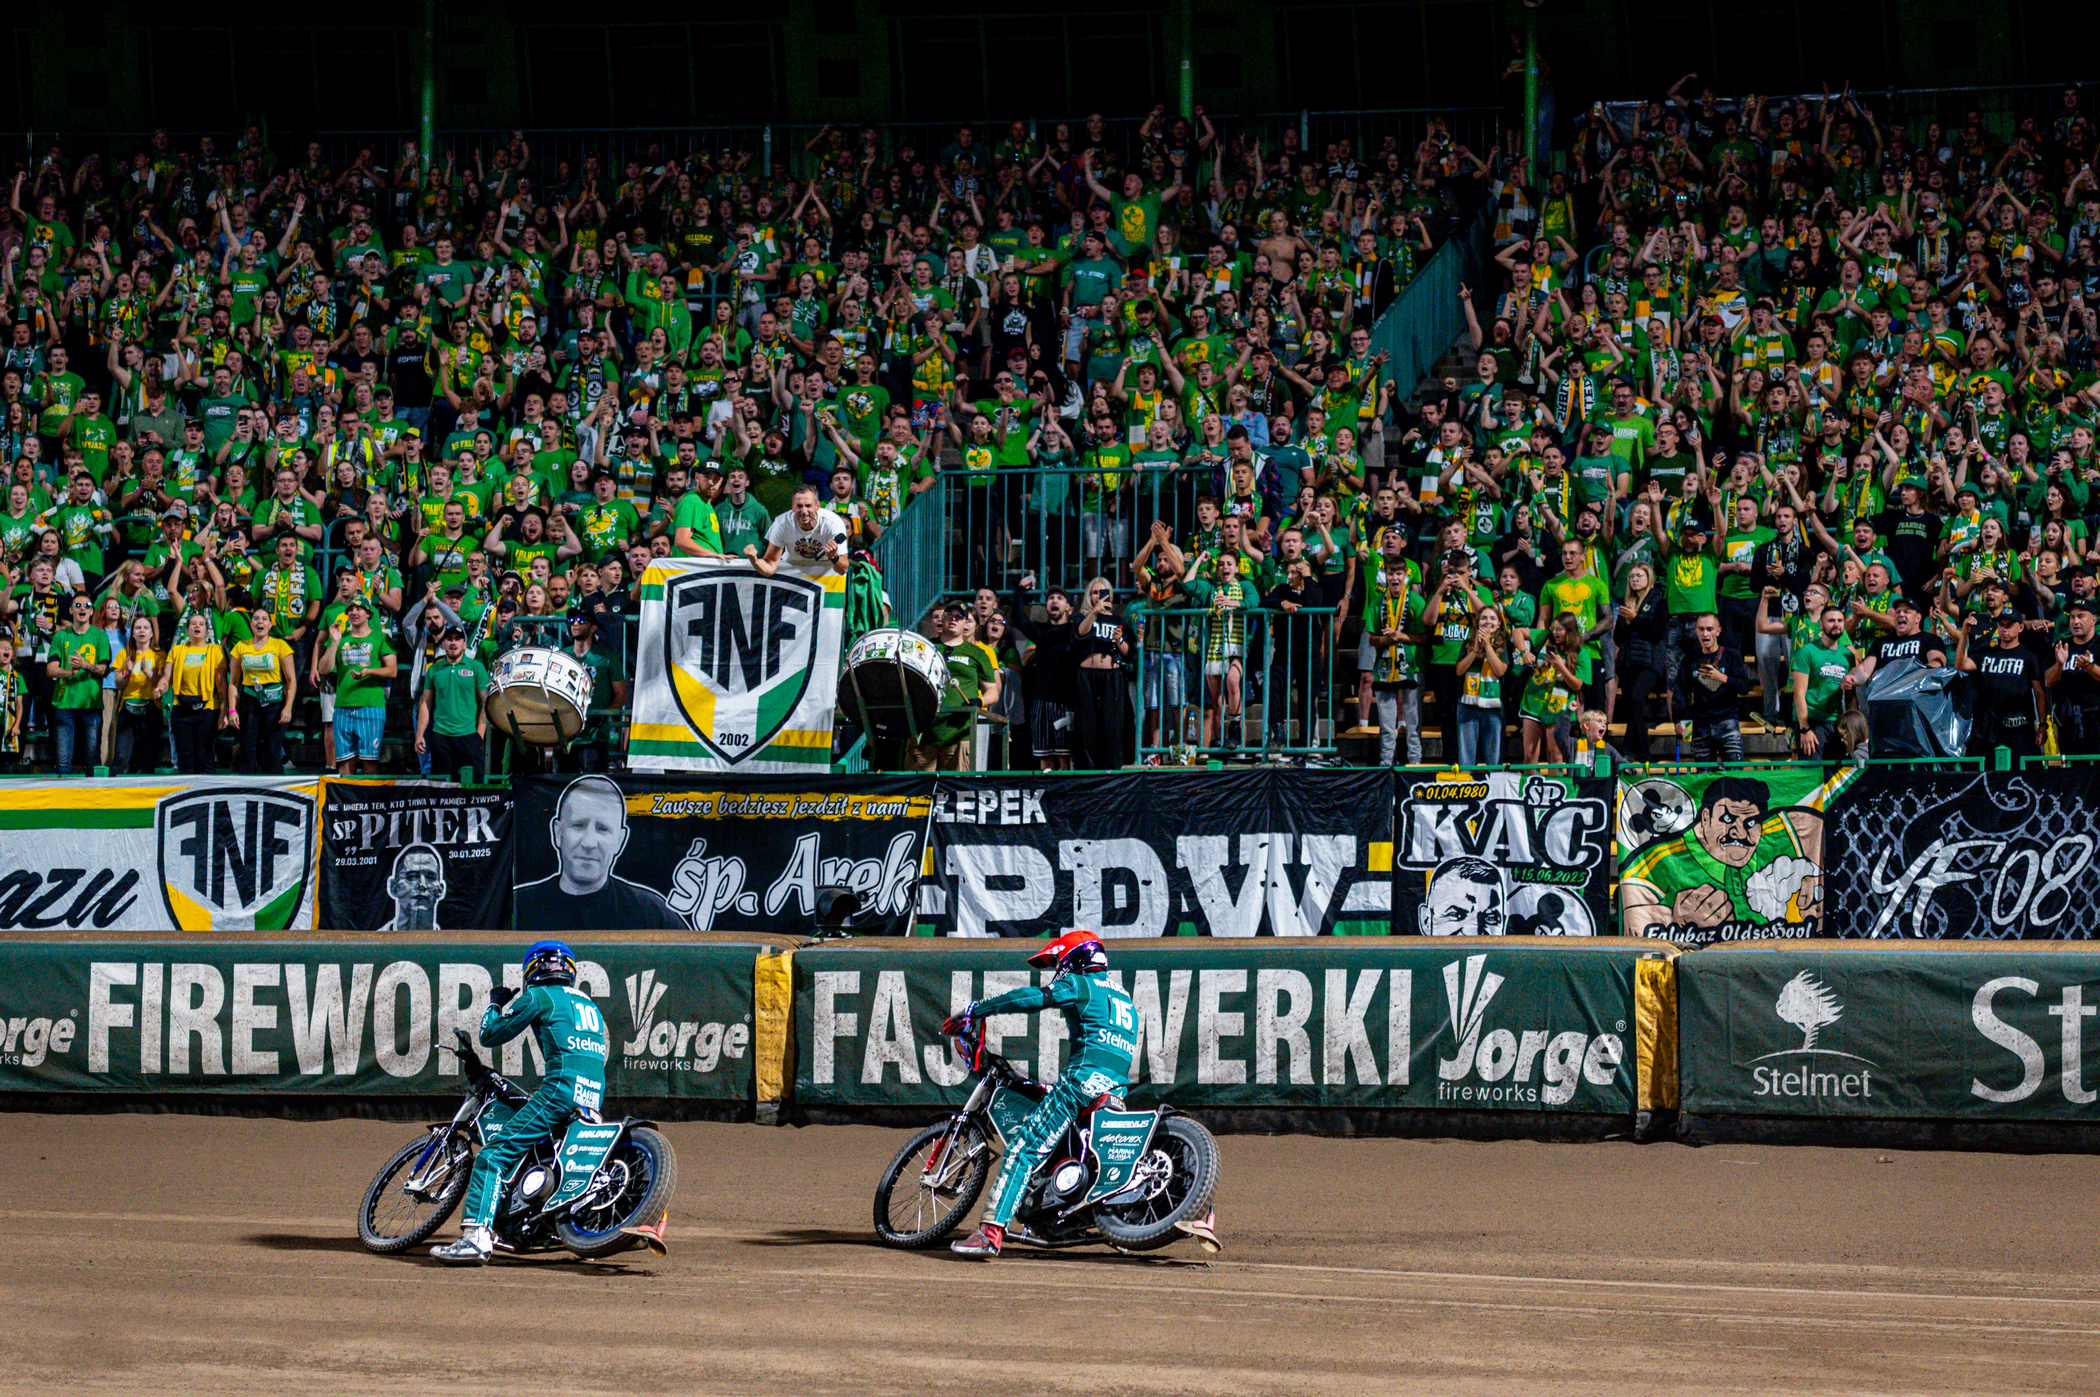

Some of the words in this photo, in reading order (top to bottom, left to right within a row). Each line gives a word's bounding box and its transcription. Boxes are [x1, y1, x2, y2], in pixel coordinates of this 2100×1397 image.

[1880, 640, 1921, 659] FLOTA
[1981, 655, 2024, 676] FLOTA
[719, 732, 749, 747] 2002
[1426, 785, 1487, 799] 01.04.1980
[328, 803, 339, 812] NIE
[343, 802, 369, 811] UMIERA
[390, 800, 405, 809] KTO
[408, 798, 427, 807] TRWA
[430, 798, 437, 806] W
[651, 795, 713, 815] Zawsze
[851, 801, 861, 815] z
[866, 798, 910, 816] nami
[358, 806, 501, 851] PITER
[1407, 803, 1595, 866] KAC
[335, 856, 378, 867] 29.03.2001
[449, 848, 491, 859] 30.01.2025
[765, 831, 918, 916] Arek
[1521, 868, 1588, 884] 15.06.2025
[666, 838, 758, 931] śp.
[1647, 926, 1717, 944] Falubaz
[575, 1002, 599, 1033] 10
[1112, 996, 1133, 1031] 15
[0, 1017, 76, 1067] rge
[623, 1055, 691, 1072] fireworks
[1438, 1081, 1537, 1102] fireworks
[1752, 1065, 1872, 1098] Stelmet
